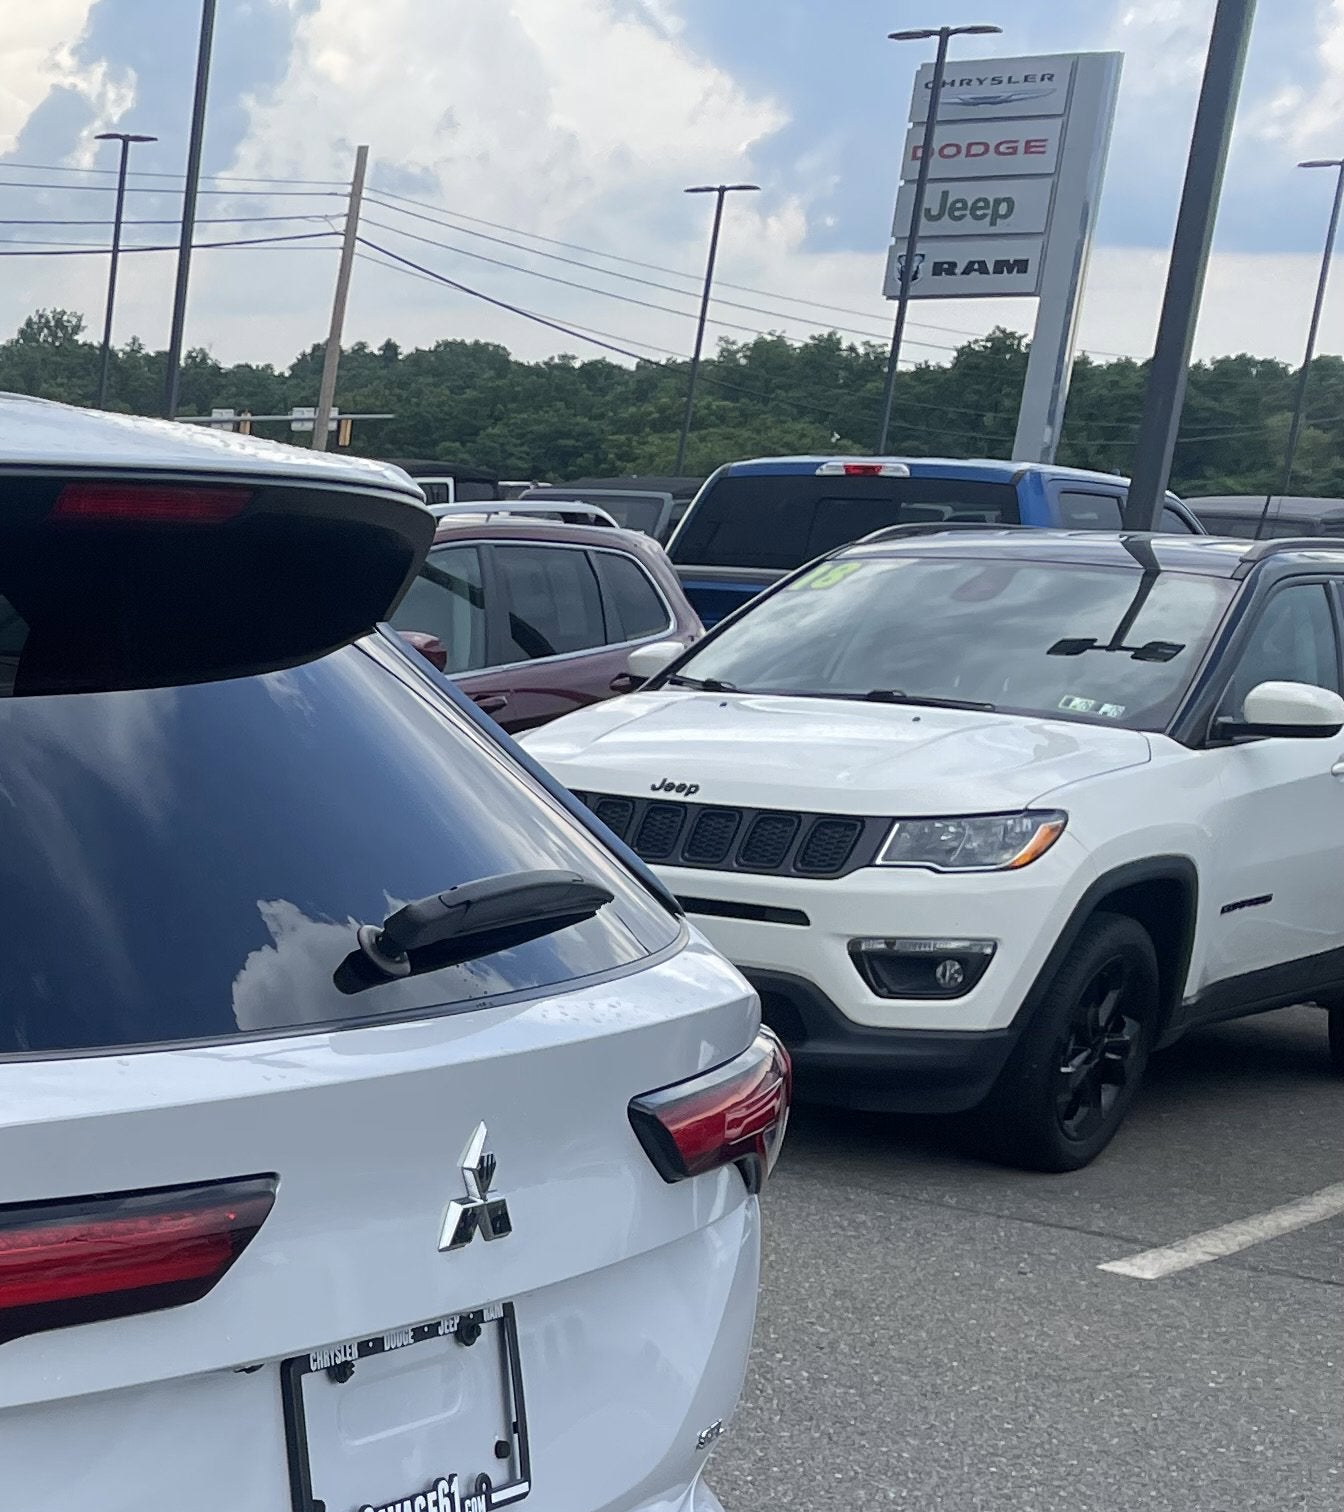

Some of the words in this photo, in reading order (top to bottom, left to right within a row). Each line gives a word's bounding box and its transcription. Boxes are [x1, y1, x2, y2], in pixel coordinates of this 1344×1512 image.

[924, 73, 1055, 90] CHRYSLER
[911, 138, 1049, 161] DODGE
[924, 190, 1015, 227] Jeep
[931, 258, 1030, 277] RAM
[650, 777, 700, 797] Jeep
